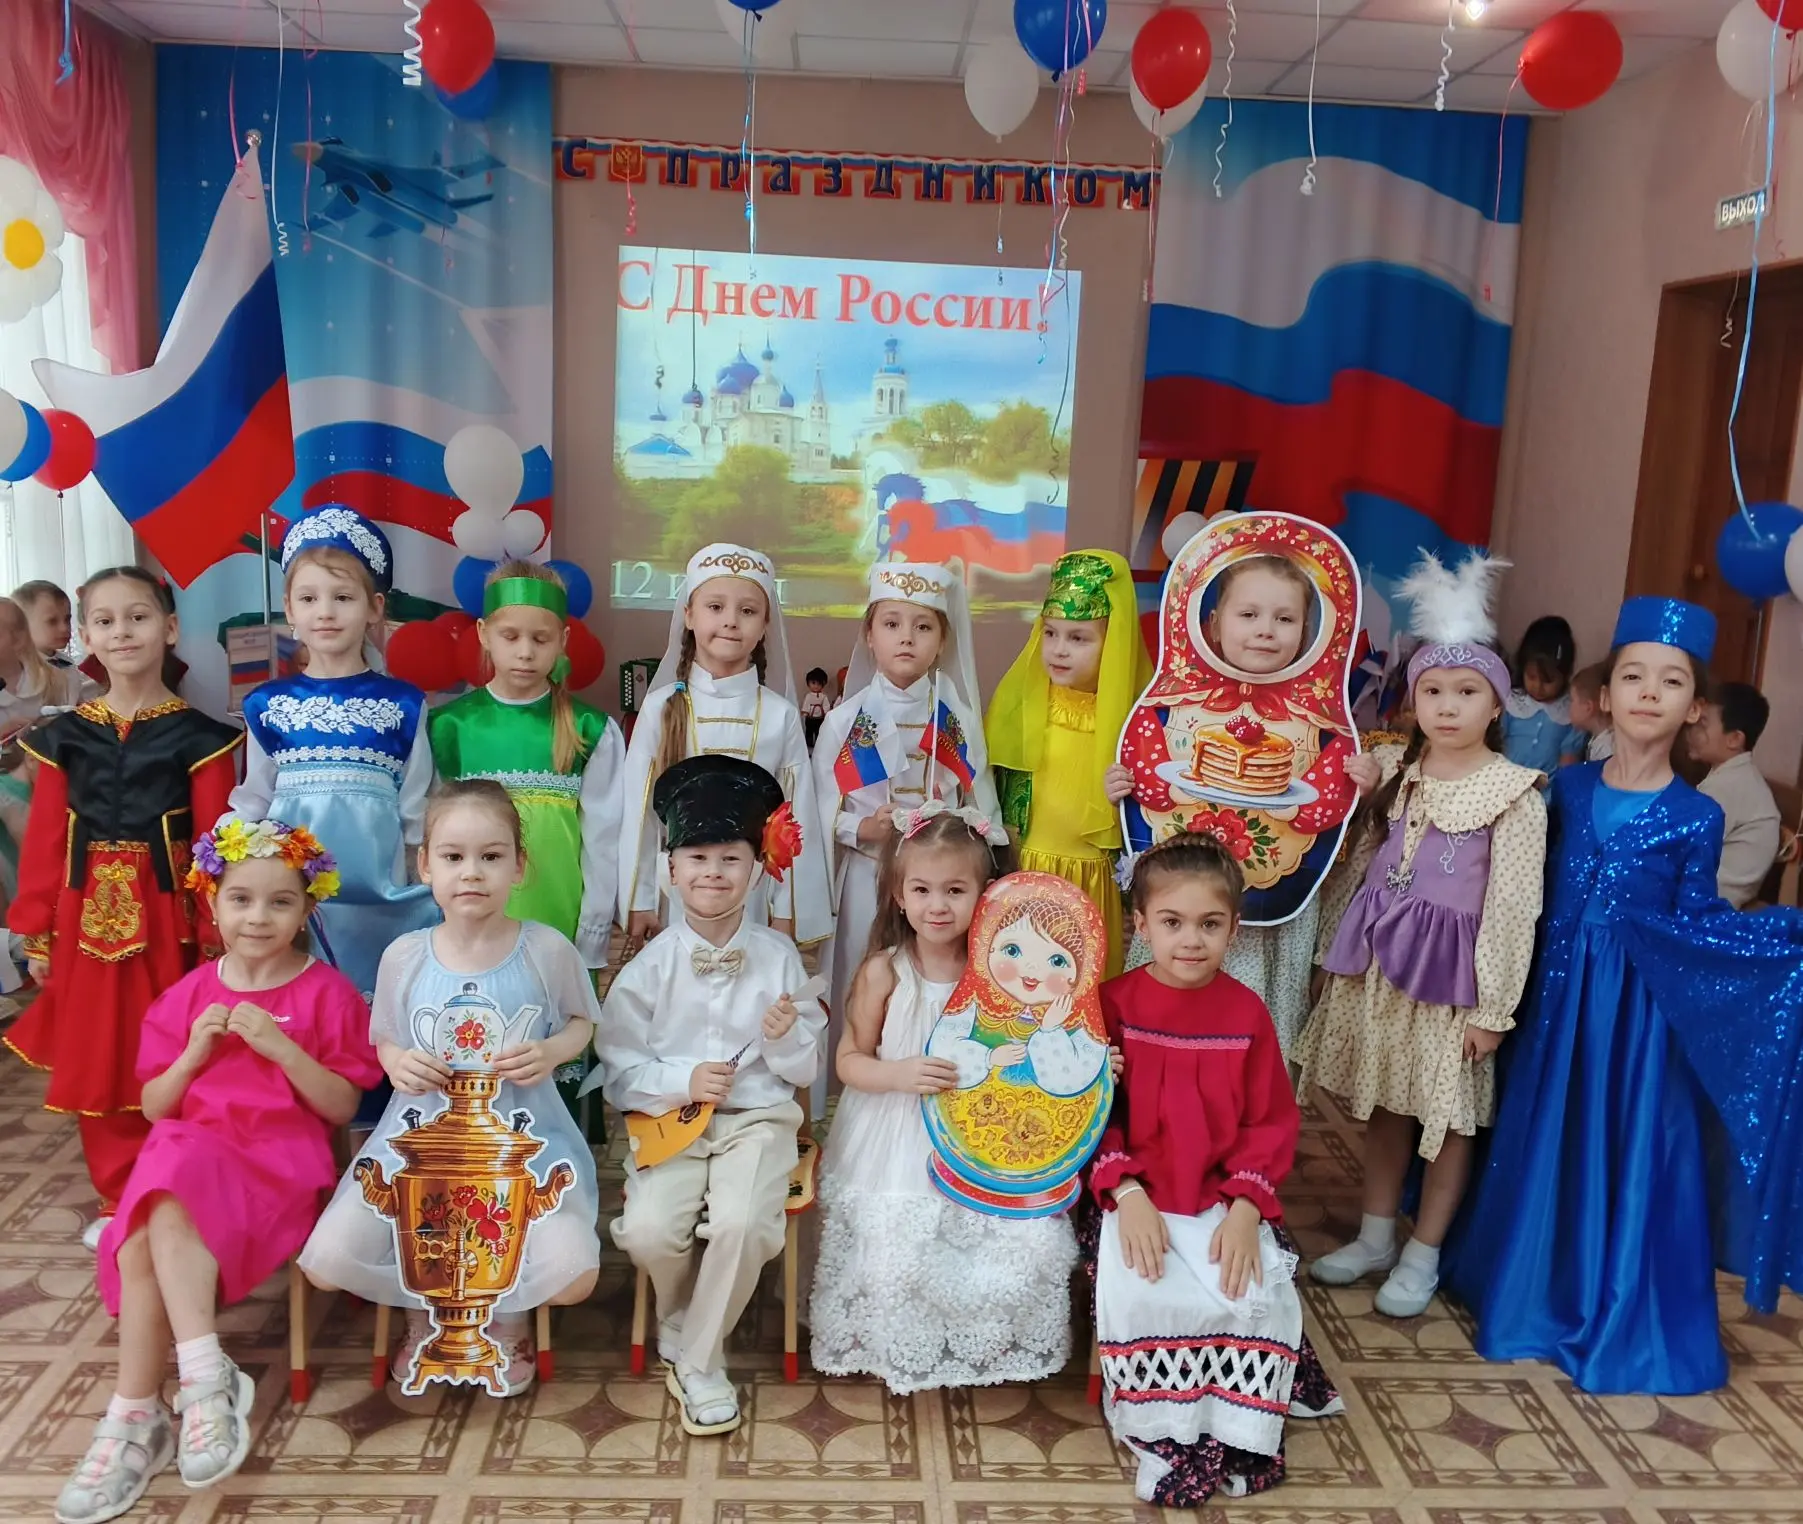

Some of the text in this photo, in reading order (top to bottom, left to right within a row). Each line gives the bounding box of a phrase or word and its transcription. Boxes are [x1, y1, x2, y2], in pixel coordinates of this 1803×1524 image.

[617, 260, 1048, 332] С Днем России!
[610, 561, 653, 599] 12
